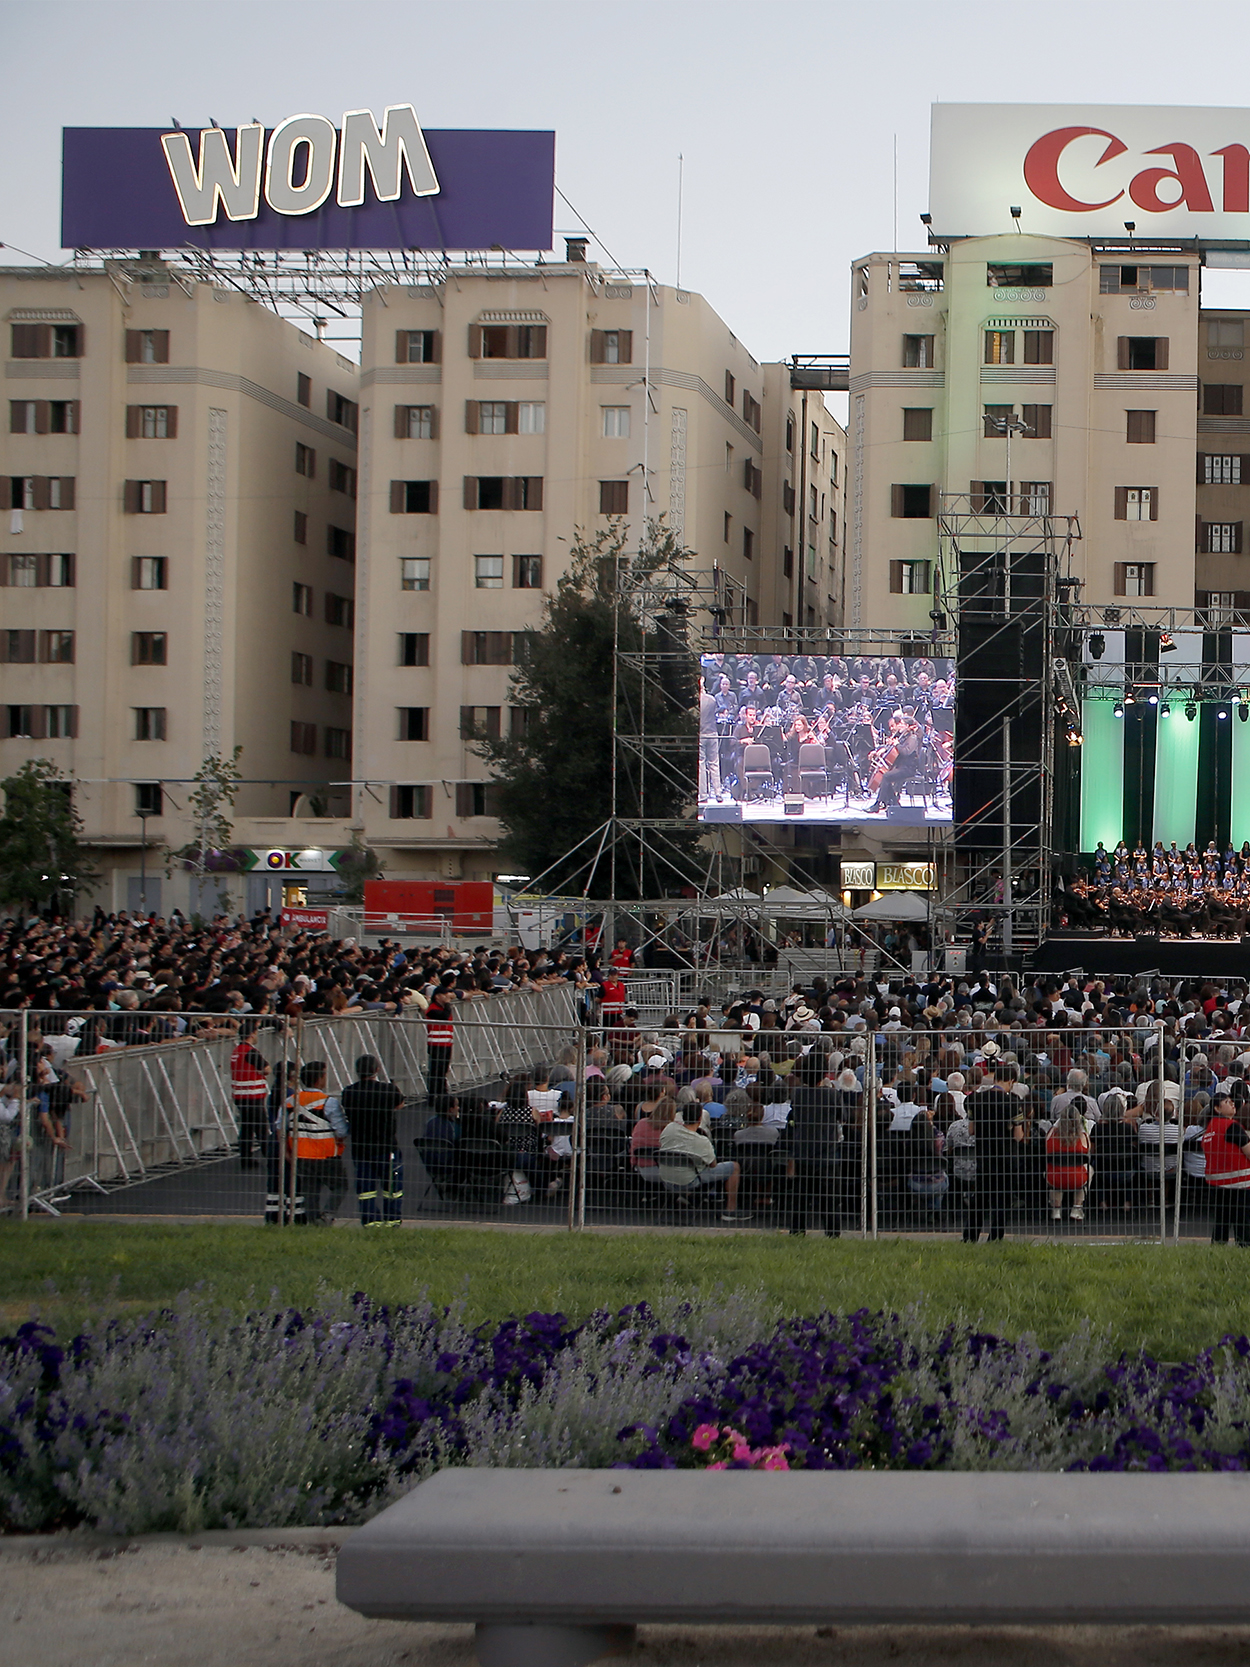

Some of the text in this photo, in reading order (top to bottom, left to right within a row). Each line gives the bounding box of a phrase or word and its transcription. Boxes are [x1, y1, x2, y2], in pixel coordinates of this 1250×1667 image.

[160, 102, 440, 227] WOM
[267, 852, 301, 869] OK
[844, 867, 873, 886] BLASCO
[883, 867, 934, 885] BLASCO
